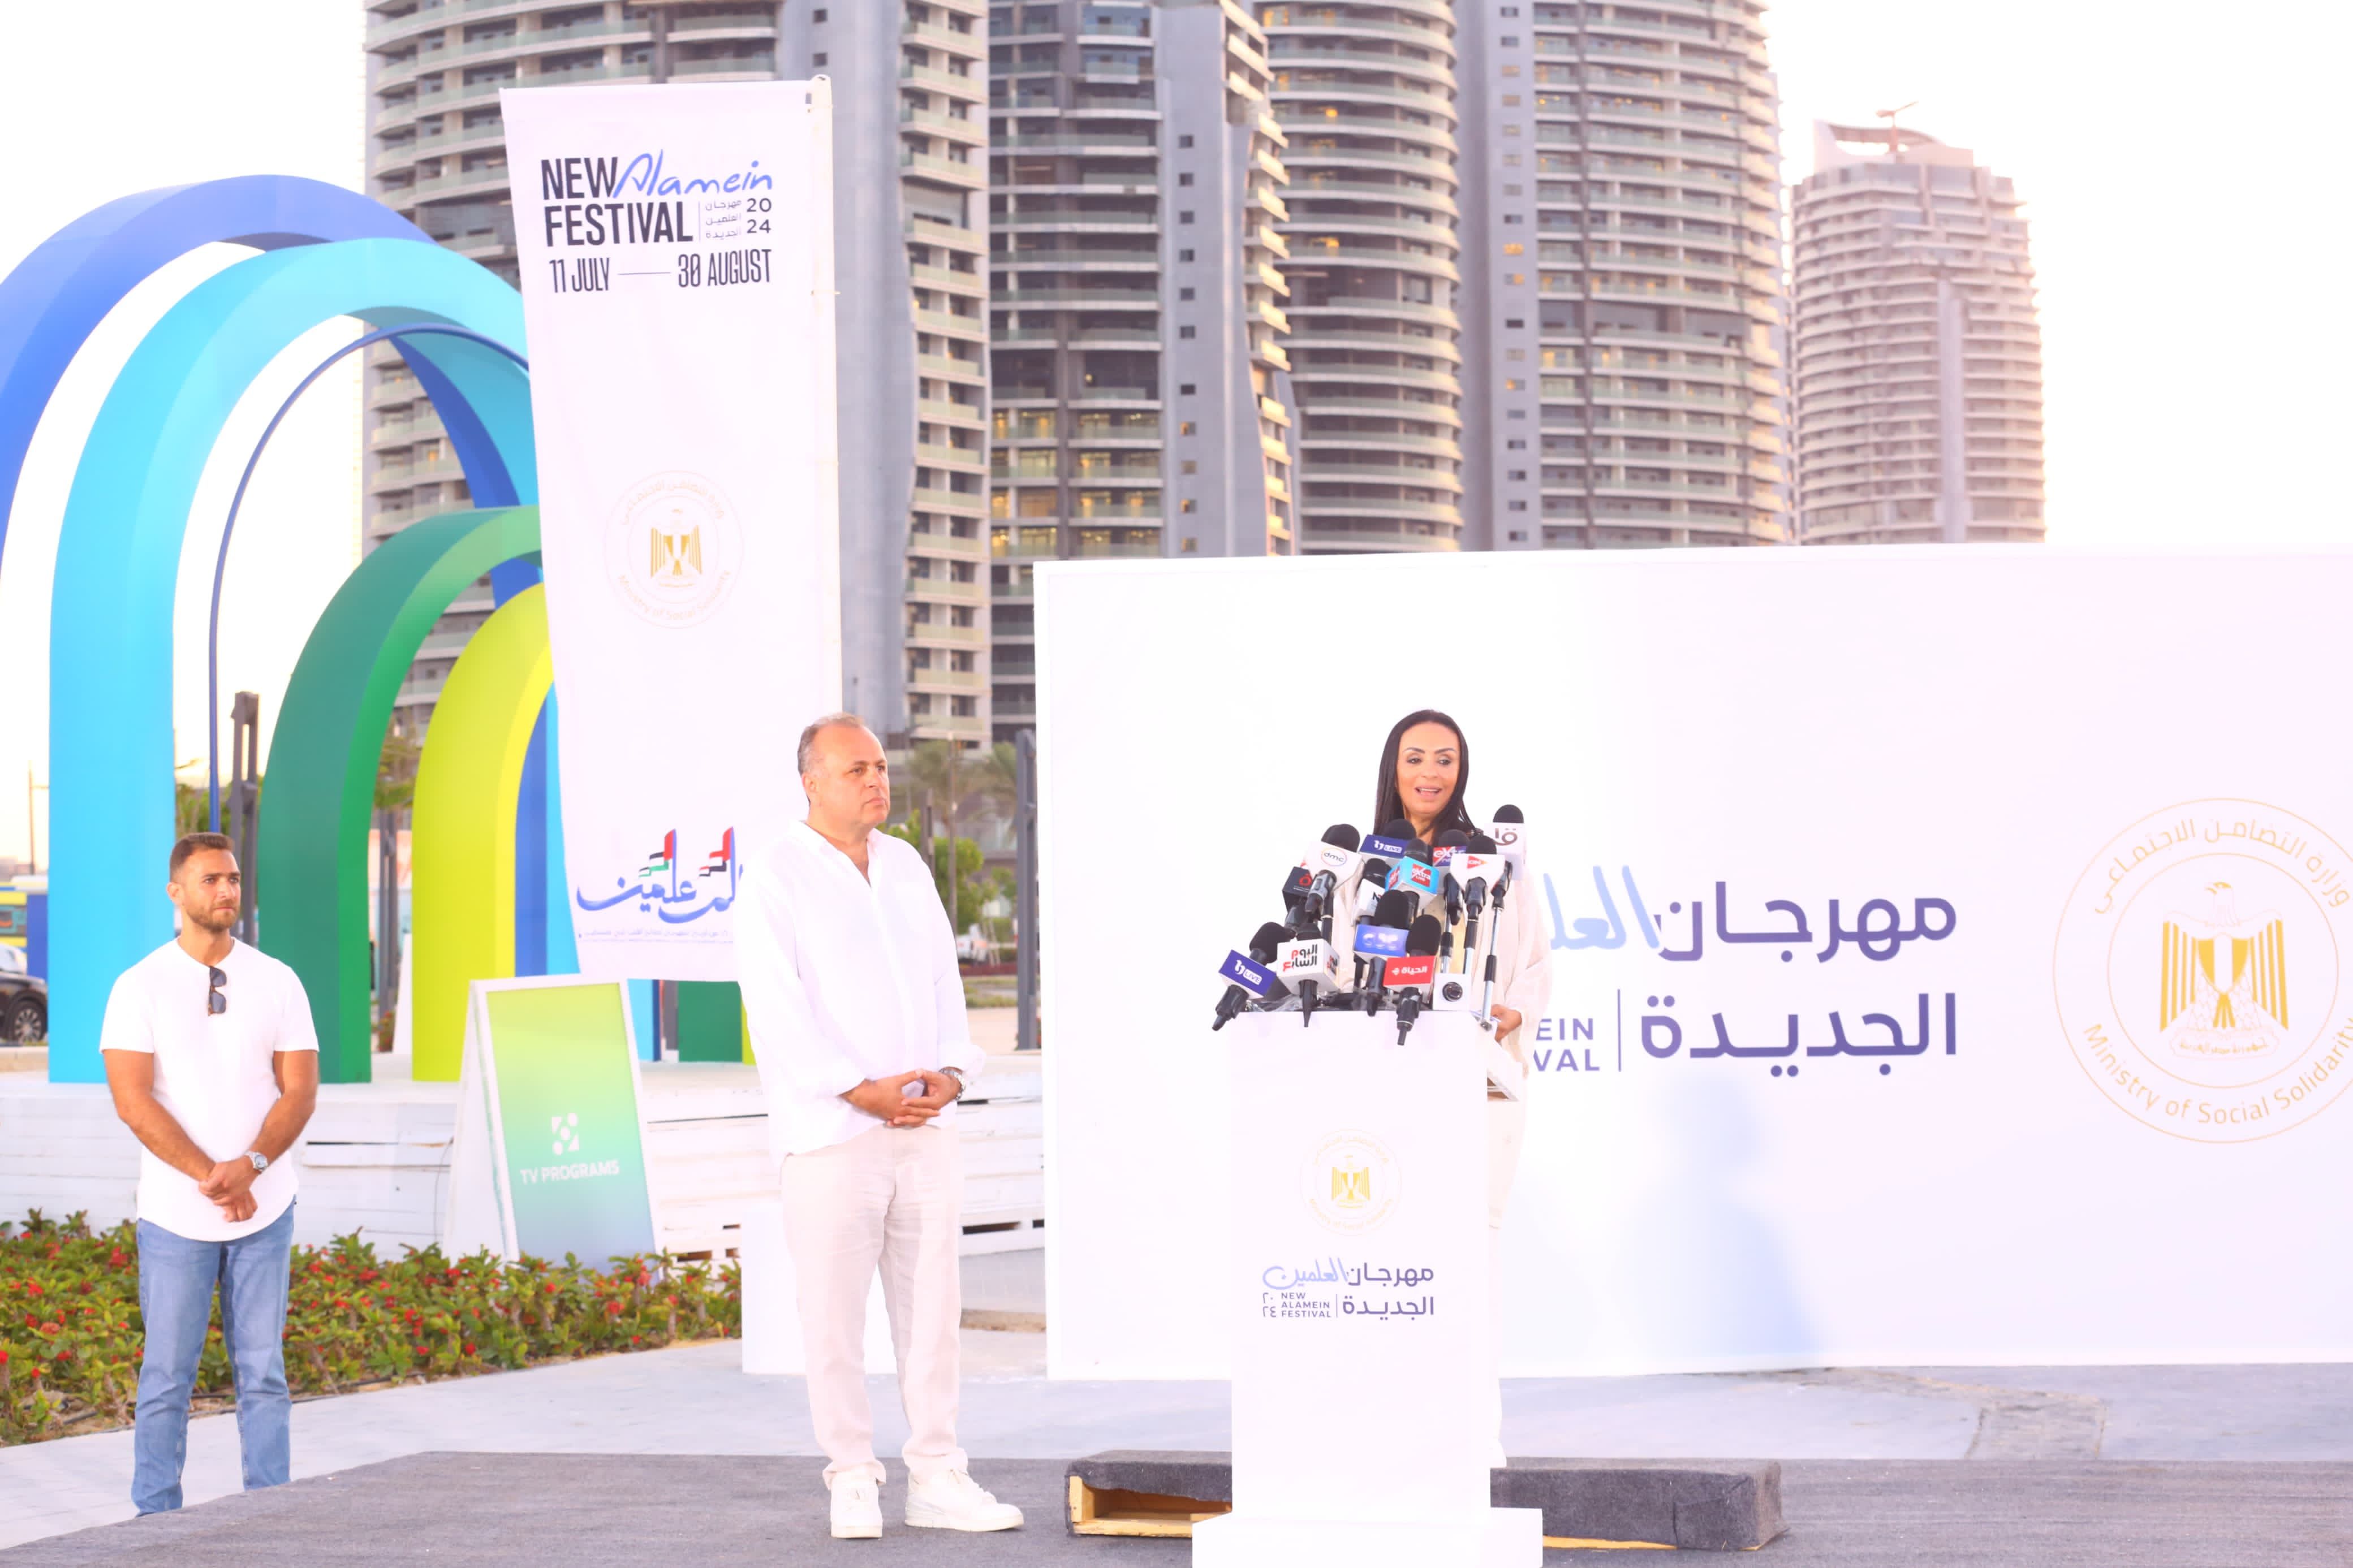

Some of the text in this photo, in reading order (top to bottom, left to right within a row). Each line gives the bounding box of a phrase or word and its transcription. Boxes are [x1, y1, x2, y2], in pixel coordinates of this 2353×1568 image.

[541, 149, 773, 200] NEW Alamein
[746, 197, 772, 213] 20
[544, 201, 693, 247] FESTIVAL
[746, 218, 772, 234] 24
[549, 248, 772, 293] 11 JULY 30 AUGUST
[1323, 850, 1344, 863] dmc
[2094, 817, 2351, 915] وزارة التضامن الاجتماعي
[1544, 865, 1957, 964] مهرجان العل
[1283, 955, 1317, 973] السابع
[1291, 944, 1318, 960] اليوم
[1401, 965, 1428, 975] الحياة
[1641, 992, 1956, 1078] الجديدة
[2082, 1021, 2162, 1112] Ministry
[2164, 1096, 2195, 1119] of
[2197, 1095, 2272, 1126] Social
[519, 1159, 620, 1185] TV PROGRAMS
[1262, 1256, 1434, 1290] مهرجان العلمين
[1281, 1310, 1331, 1318] FESTIVAL
[1342, 1295, 1434, 1321] الجديدة
